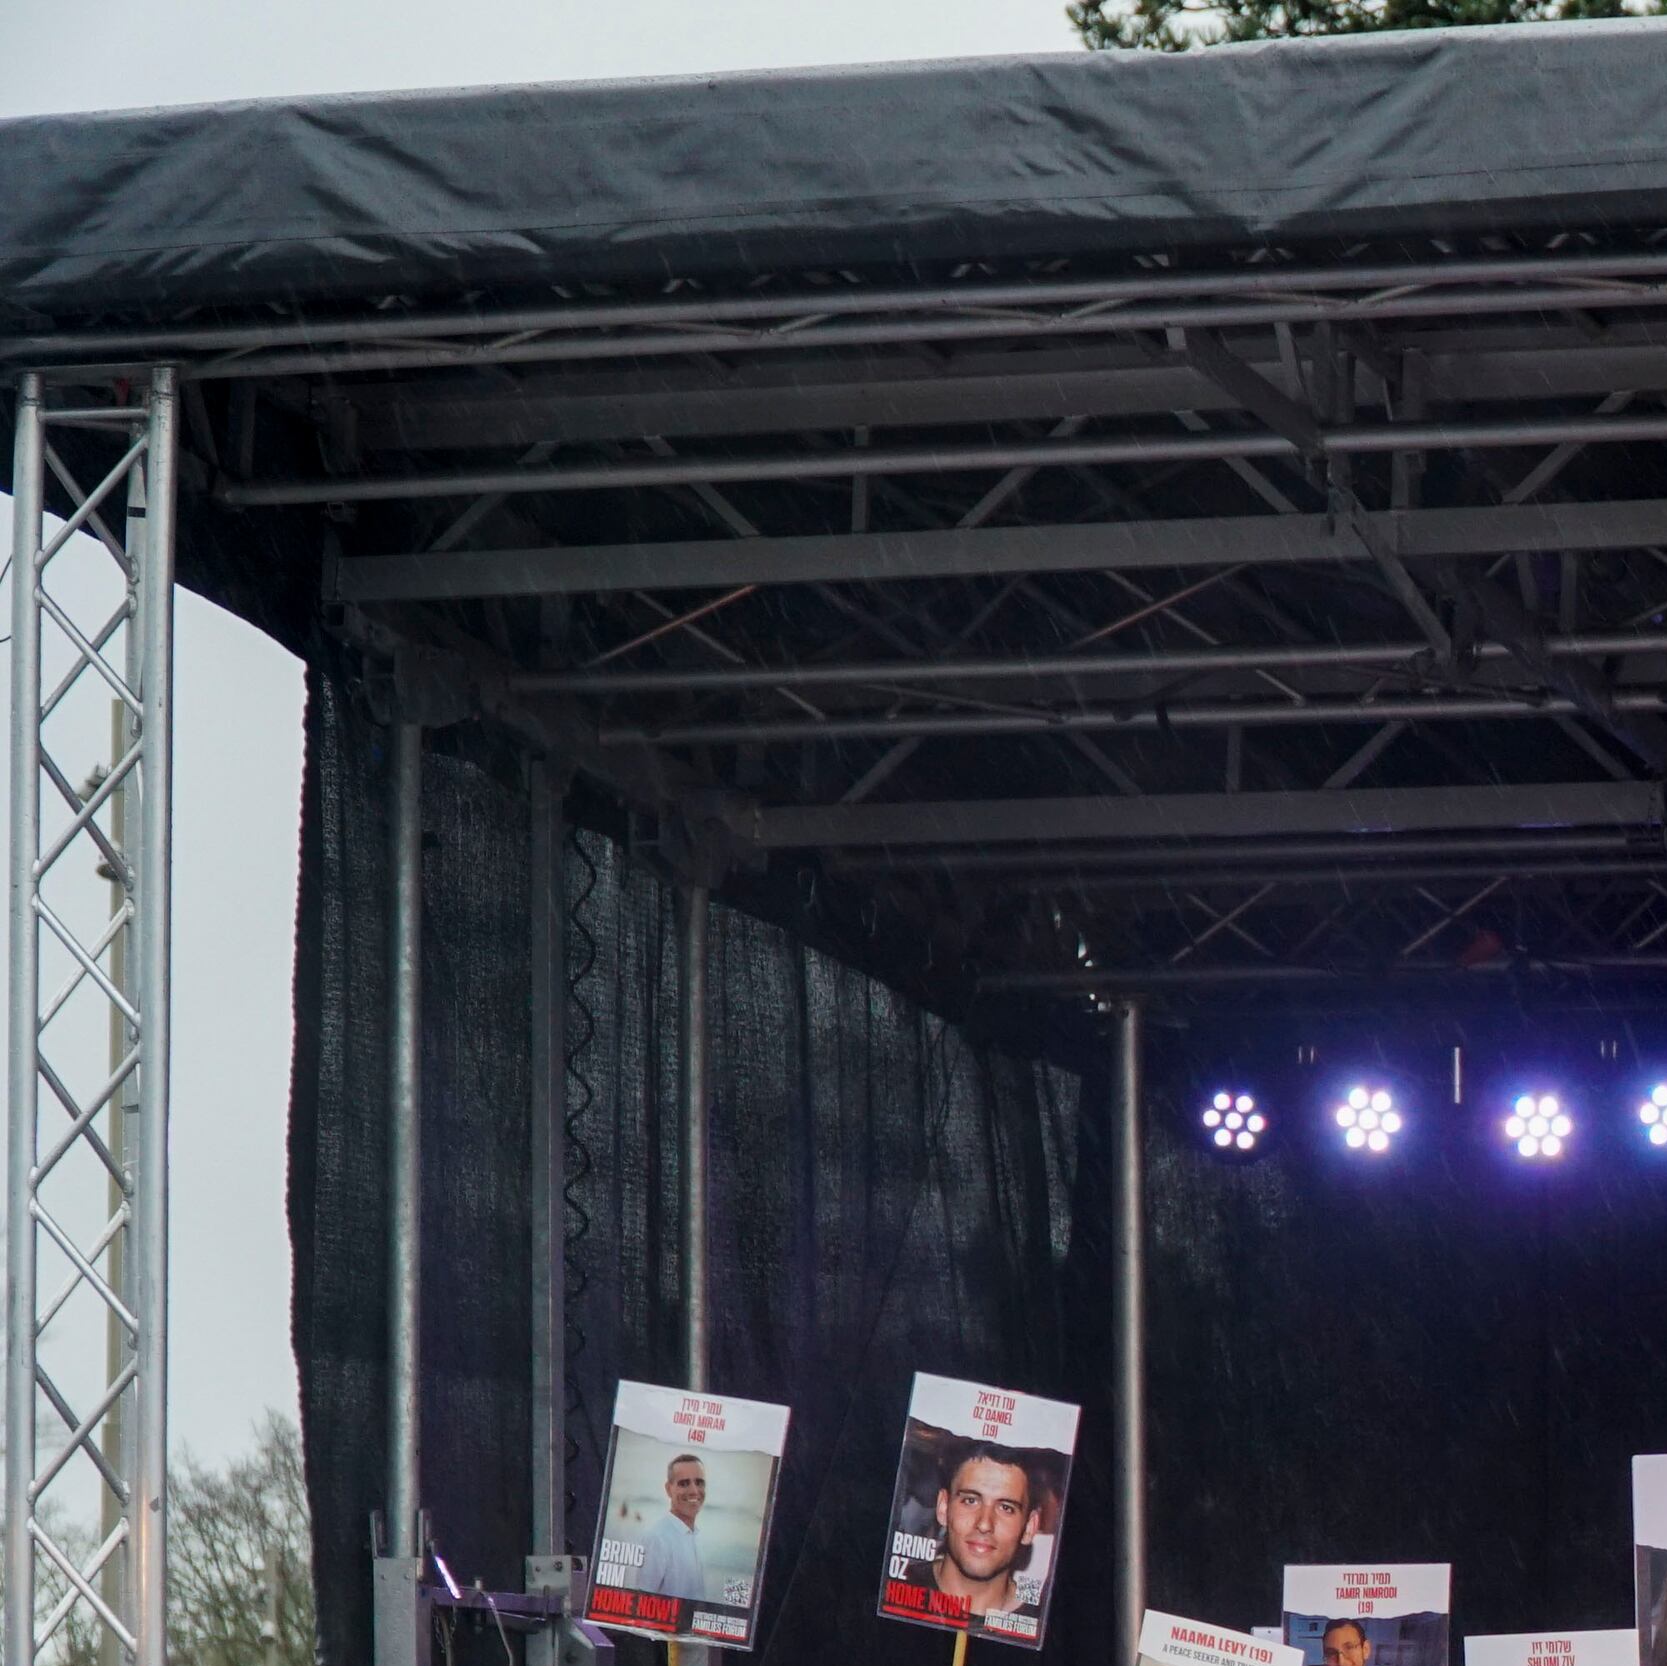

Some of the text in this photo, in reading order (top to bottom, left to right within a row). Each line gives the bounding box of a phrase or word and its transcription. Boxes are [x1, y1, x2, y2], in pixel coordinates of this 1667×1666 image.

[673, 1413, 725, 1431] OMRI MIRAN
[973, 1406, 1012, 1425] OZ DANIEL
[688, 1429, 705, 1444] (46)
[982, 1424, 998, 1438] (19)
[601, 1539, 644, 1567] BRING
[893, 1532, 937, 1561] BRING
[596, 1564, 625, 1587] HIM
[889, 1556, 908, 1580] OZ
[887, 1582, 925, 1609] HOME
[928, 1588, 971, 1619] NOW!
[1336, 1587, 1397, 1599] TAMIR NIMRODI
[592, 1588, 633, 1613] HOME
[637, 1594, 679, 1623] NOW!
[1358, 1601, 1373, 1614] (19)
[1162, 1643, 1168, 1653] A
[1169, 1645, 1192, 1659] PEACE
[1193, 1650, 1220, 1665] SEEKER
[1171, 1626, 1272, 1664] NAAMA LEVY (19)
